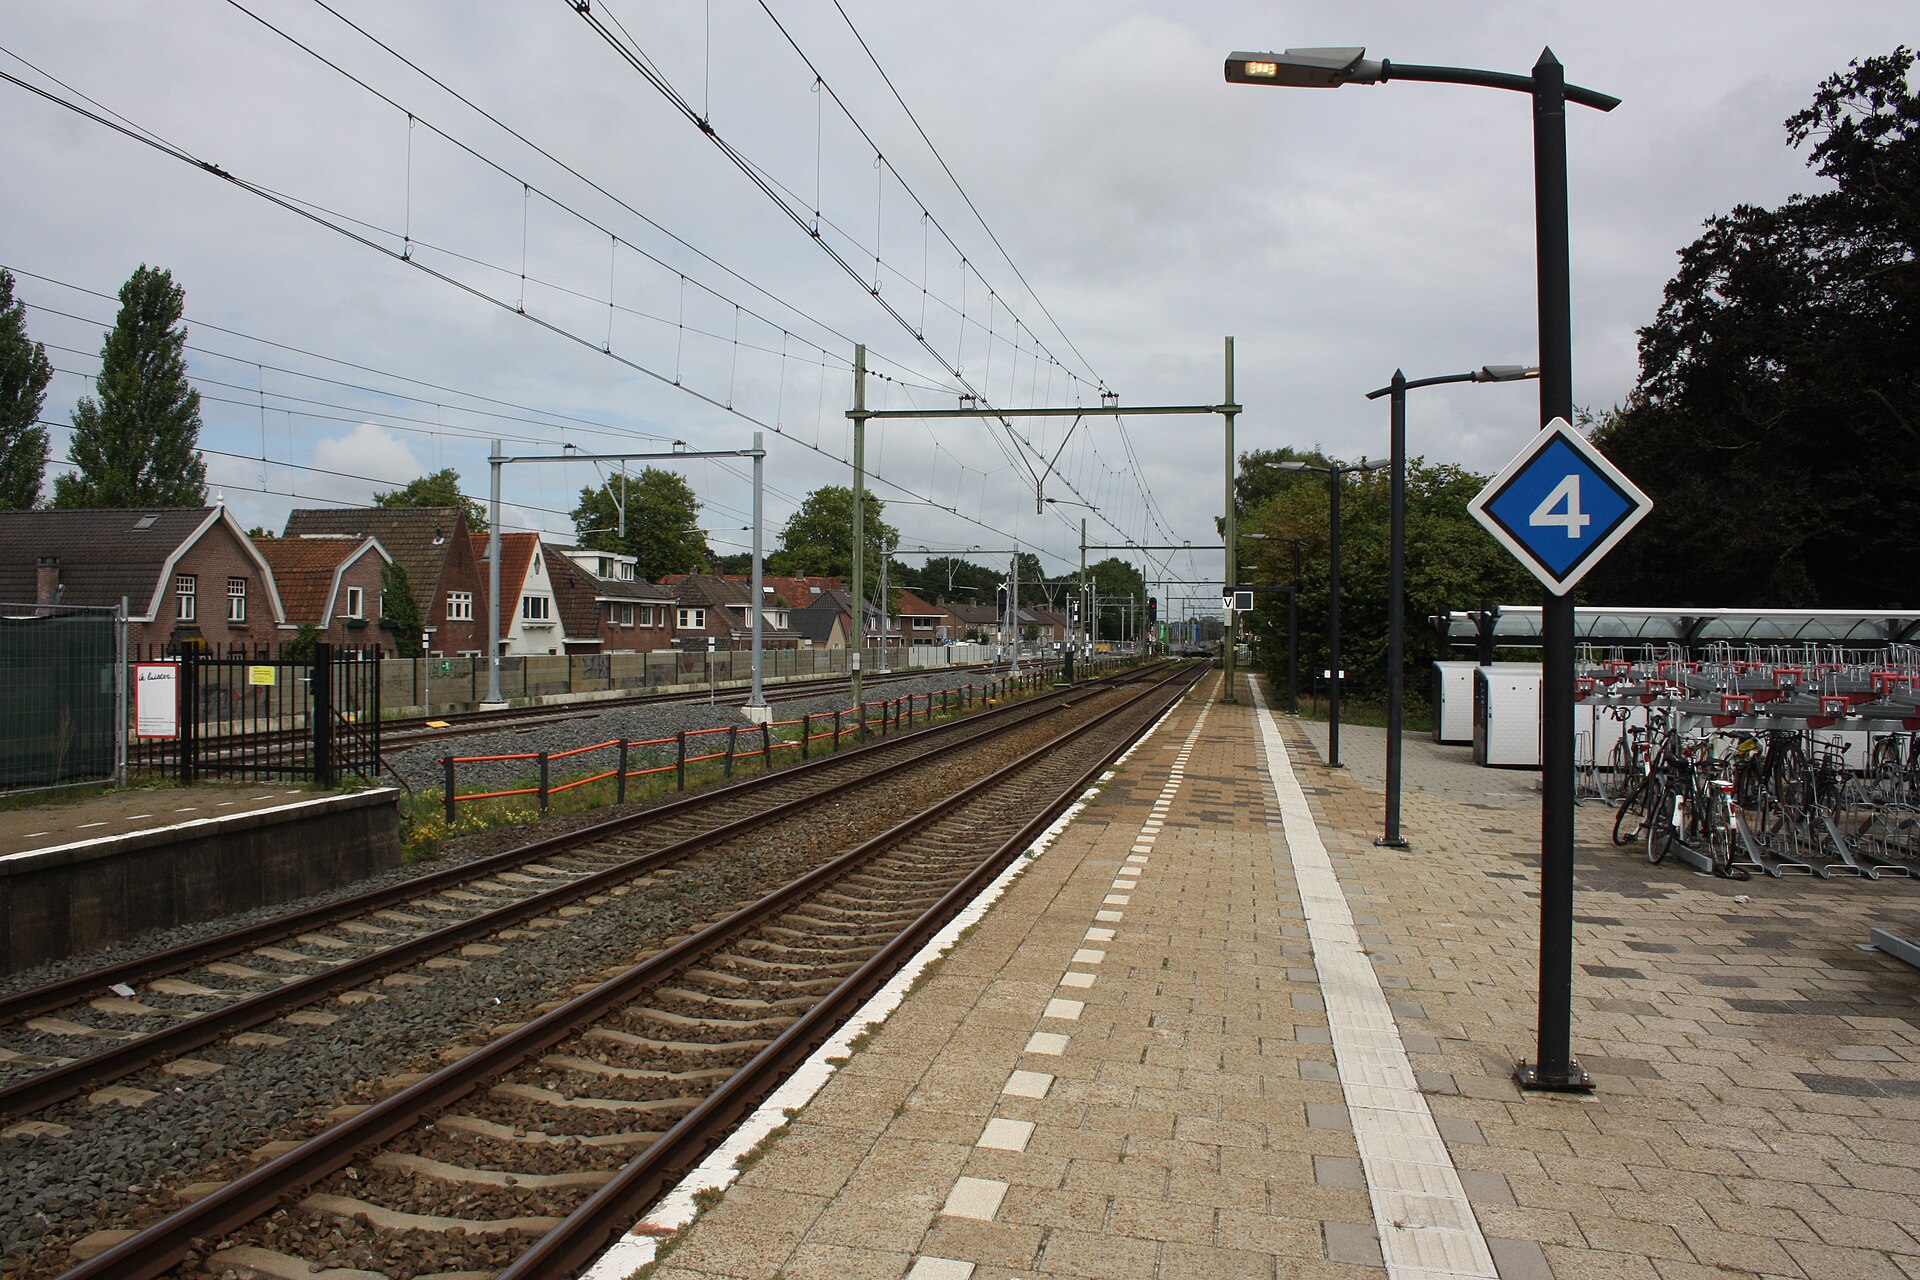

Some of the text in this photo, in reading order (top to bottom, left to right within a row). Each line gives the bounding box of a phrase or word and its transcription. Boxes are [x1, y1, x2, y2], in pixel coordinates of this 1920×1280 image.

[1529, 474, 1590, 538] 4
[1223, 598, 1232, 608] V
[138, 673, 145, 681] ik
